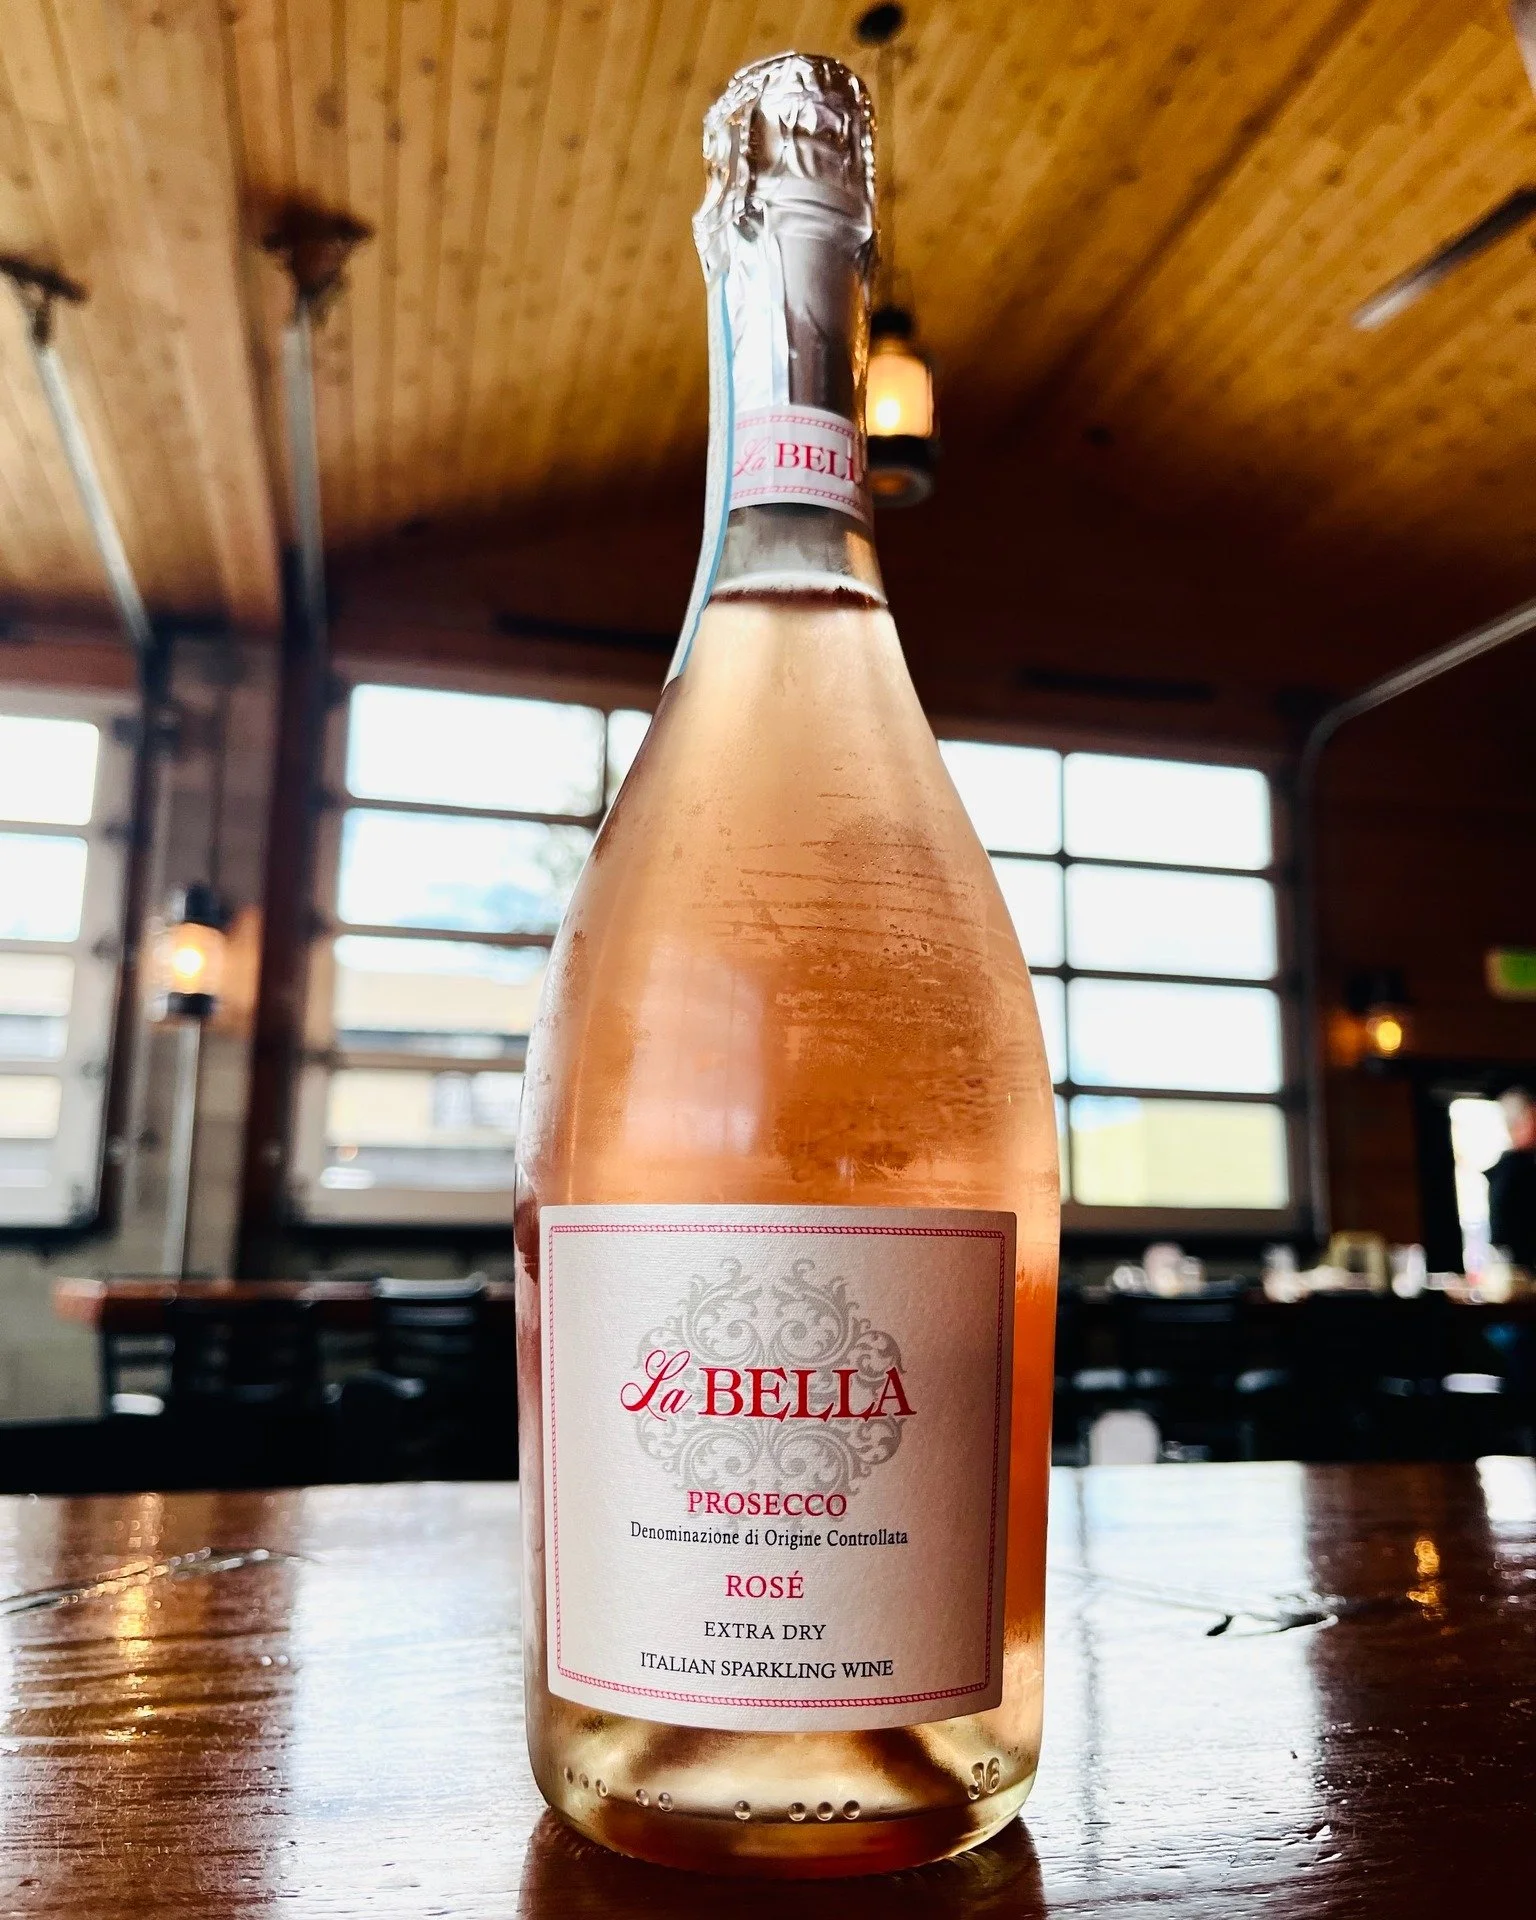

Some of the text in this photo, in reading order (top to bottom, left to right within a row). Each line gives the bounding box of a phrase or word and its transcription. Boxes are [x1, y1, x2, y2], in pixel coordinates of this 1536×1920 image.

[621, 1350, 916, 1422] La BELLA
[687, 1490, 848, 1517] PROSECCO
[630, 1521, 909, 1551] Denominazione di Origine Controllata
[725, 1571, 804, 1599] ROSÉ
[703, 1621, 827, 1641] EXTRA DRY
[640, 1651, 894, 1680] ITALIAN SPARKLING WINE
